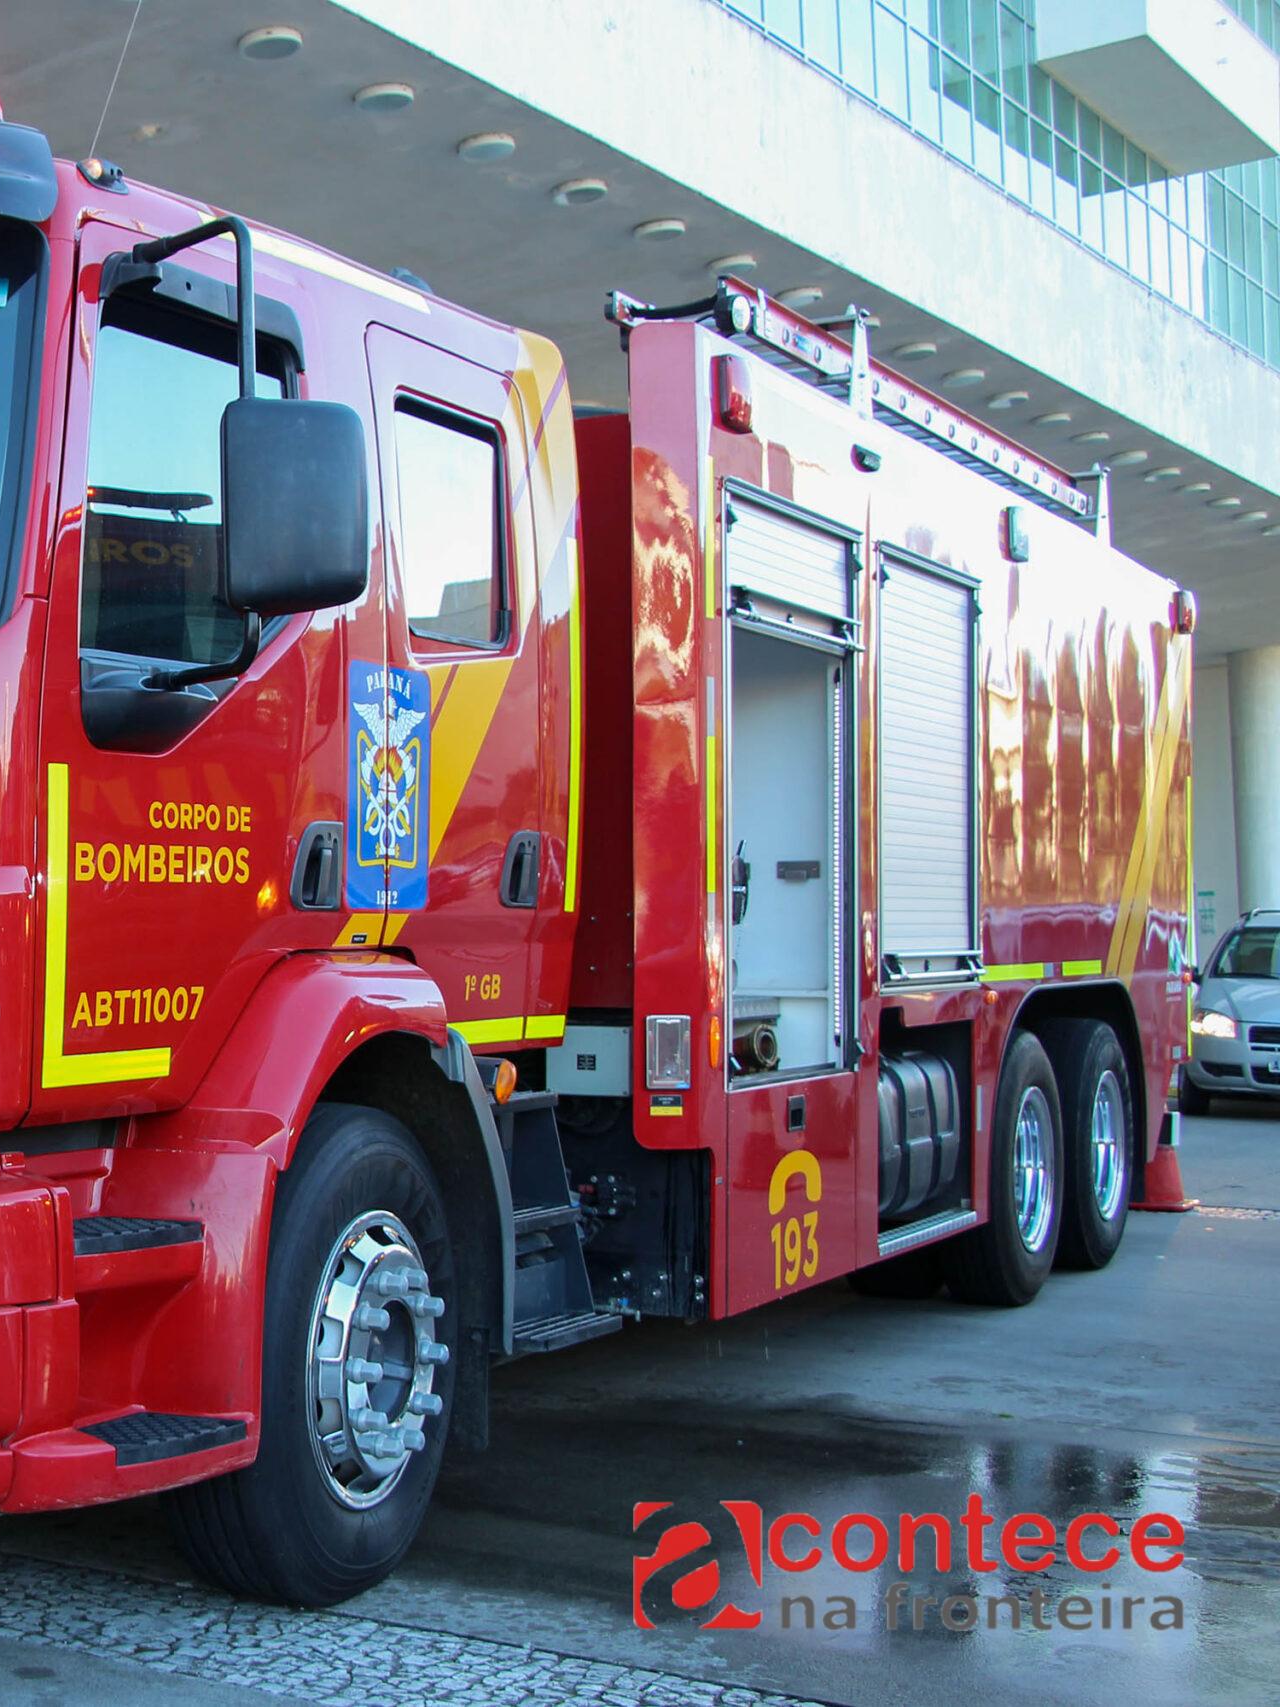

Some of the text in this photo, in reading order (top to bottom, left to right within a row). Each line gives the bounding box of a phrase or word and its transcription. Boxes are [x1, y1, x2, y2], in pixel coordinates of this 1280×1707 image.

[148, 801, 252, 833] CORPO DE
[74, 841, 251, 885] BOMBEIROS
[376, 889, 399, 905] 1912
[480, 974, 501, 1001] GB
[71, 986, 205, 1030] ABT11007
[769, 1210, 820, 1290] 193
